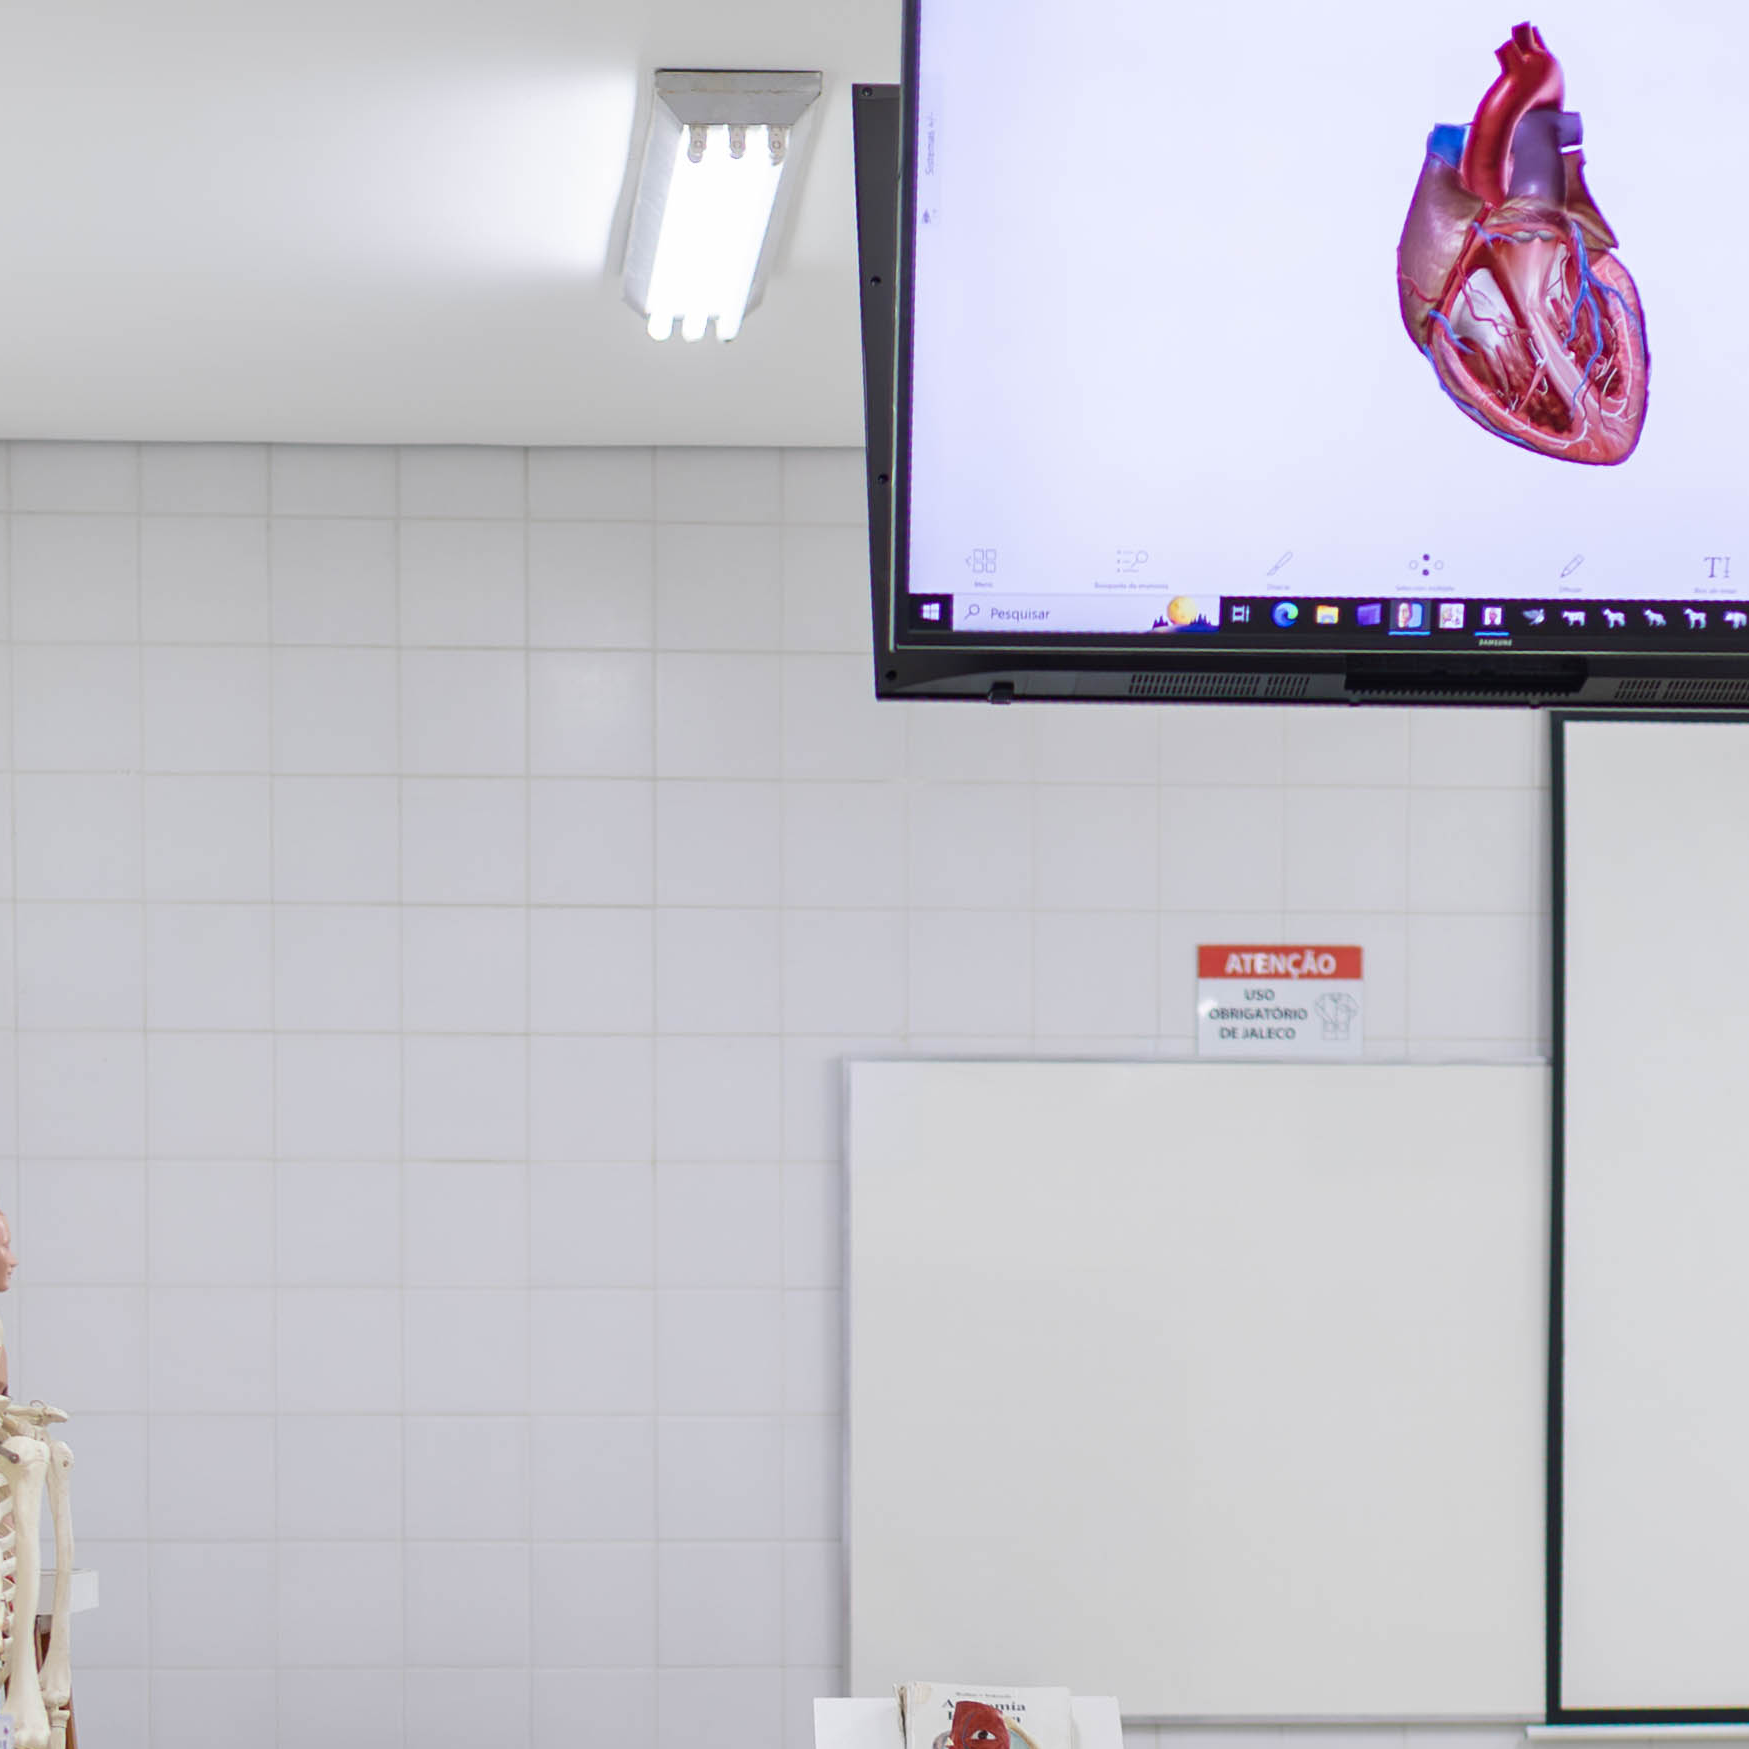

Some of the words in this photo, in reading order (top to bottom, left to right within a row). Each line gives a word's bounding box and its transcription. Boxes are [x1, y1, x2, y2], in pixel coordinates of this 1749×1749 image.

[990, 607, 1050, 622] Pesquisar
[1225, 950, 1337, 979] ATENÇÃO
[1243, 988, 1275, 1001] USO
[1208, 1006, 1308, 1020] OBRIGATÓRIO
[1219, 1027, 1238, 1040] DE
[1242, 1027, 1296, 1040] JALECO
